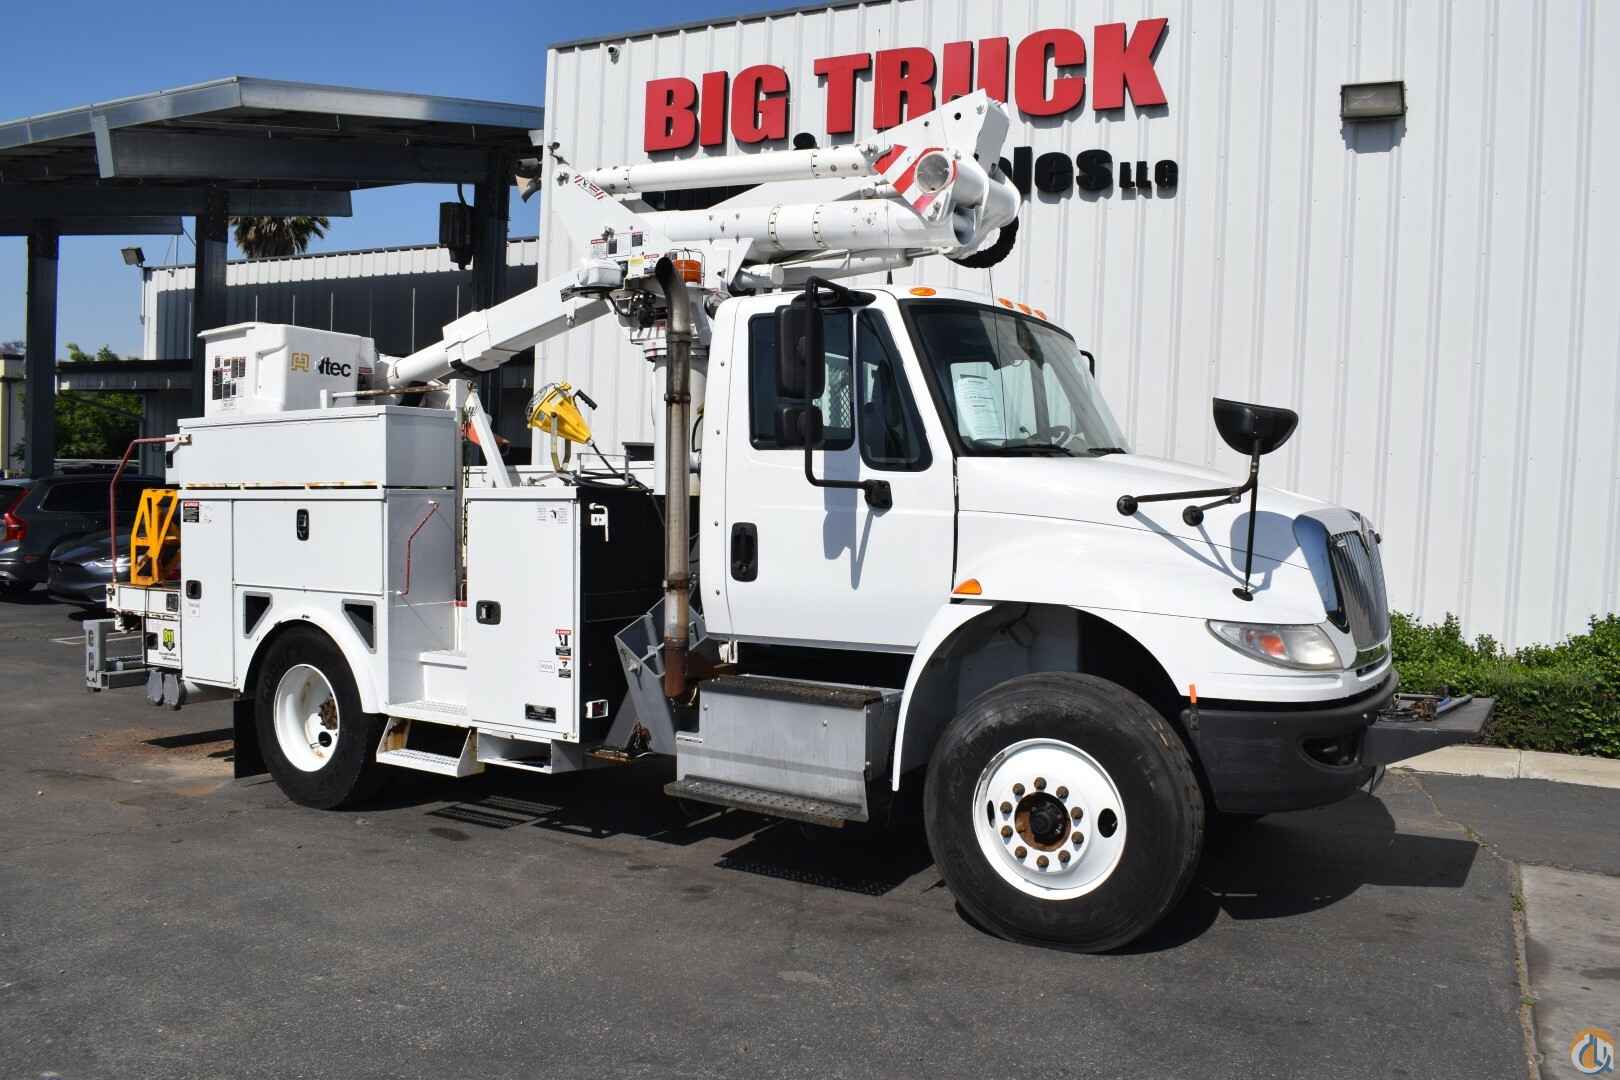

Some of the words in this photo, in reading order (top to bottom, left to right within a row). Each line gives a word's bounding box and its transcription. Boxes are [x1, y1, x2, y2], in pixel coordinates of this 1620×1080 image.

[644, 64, 788, 152] BIG
[814, 17, 1168, 134] TRUCK
[998, 146, 1113, 193] les
[314, 356, 352, 377] ltec
